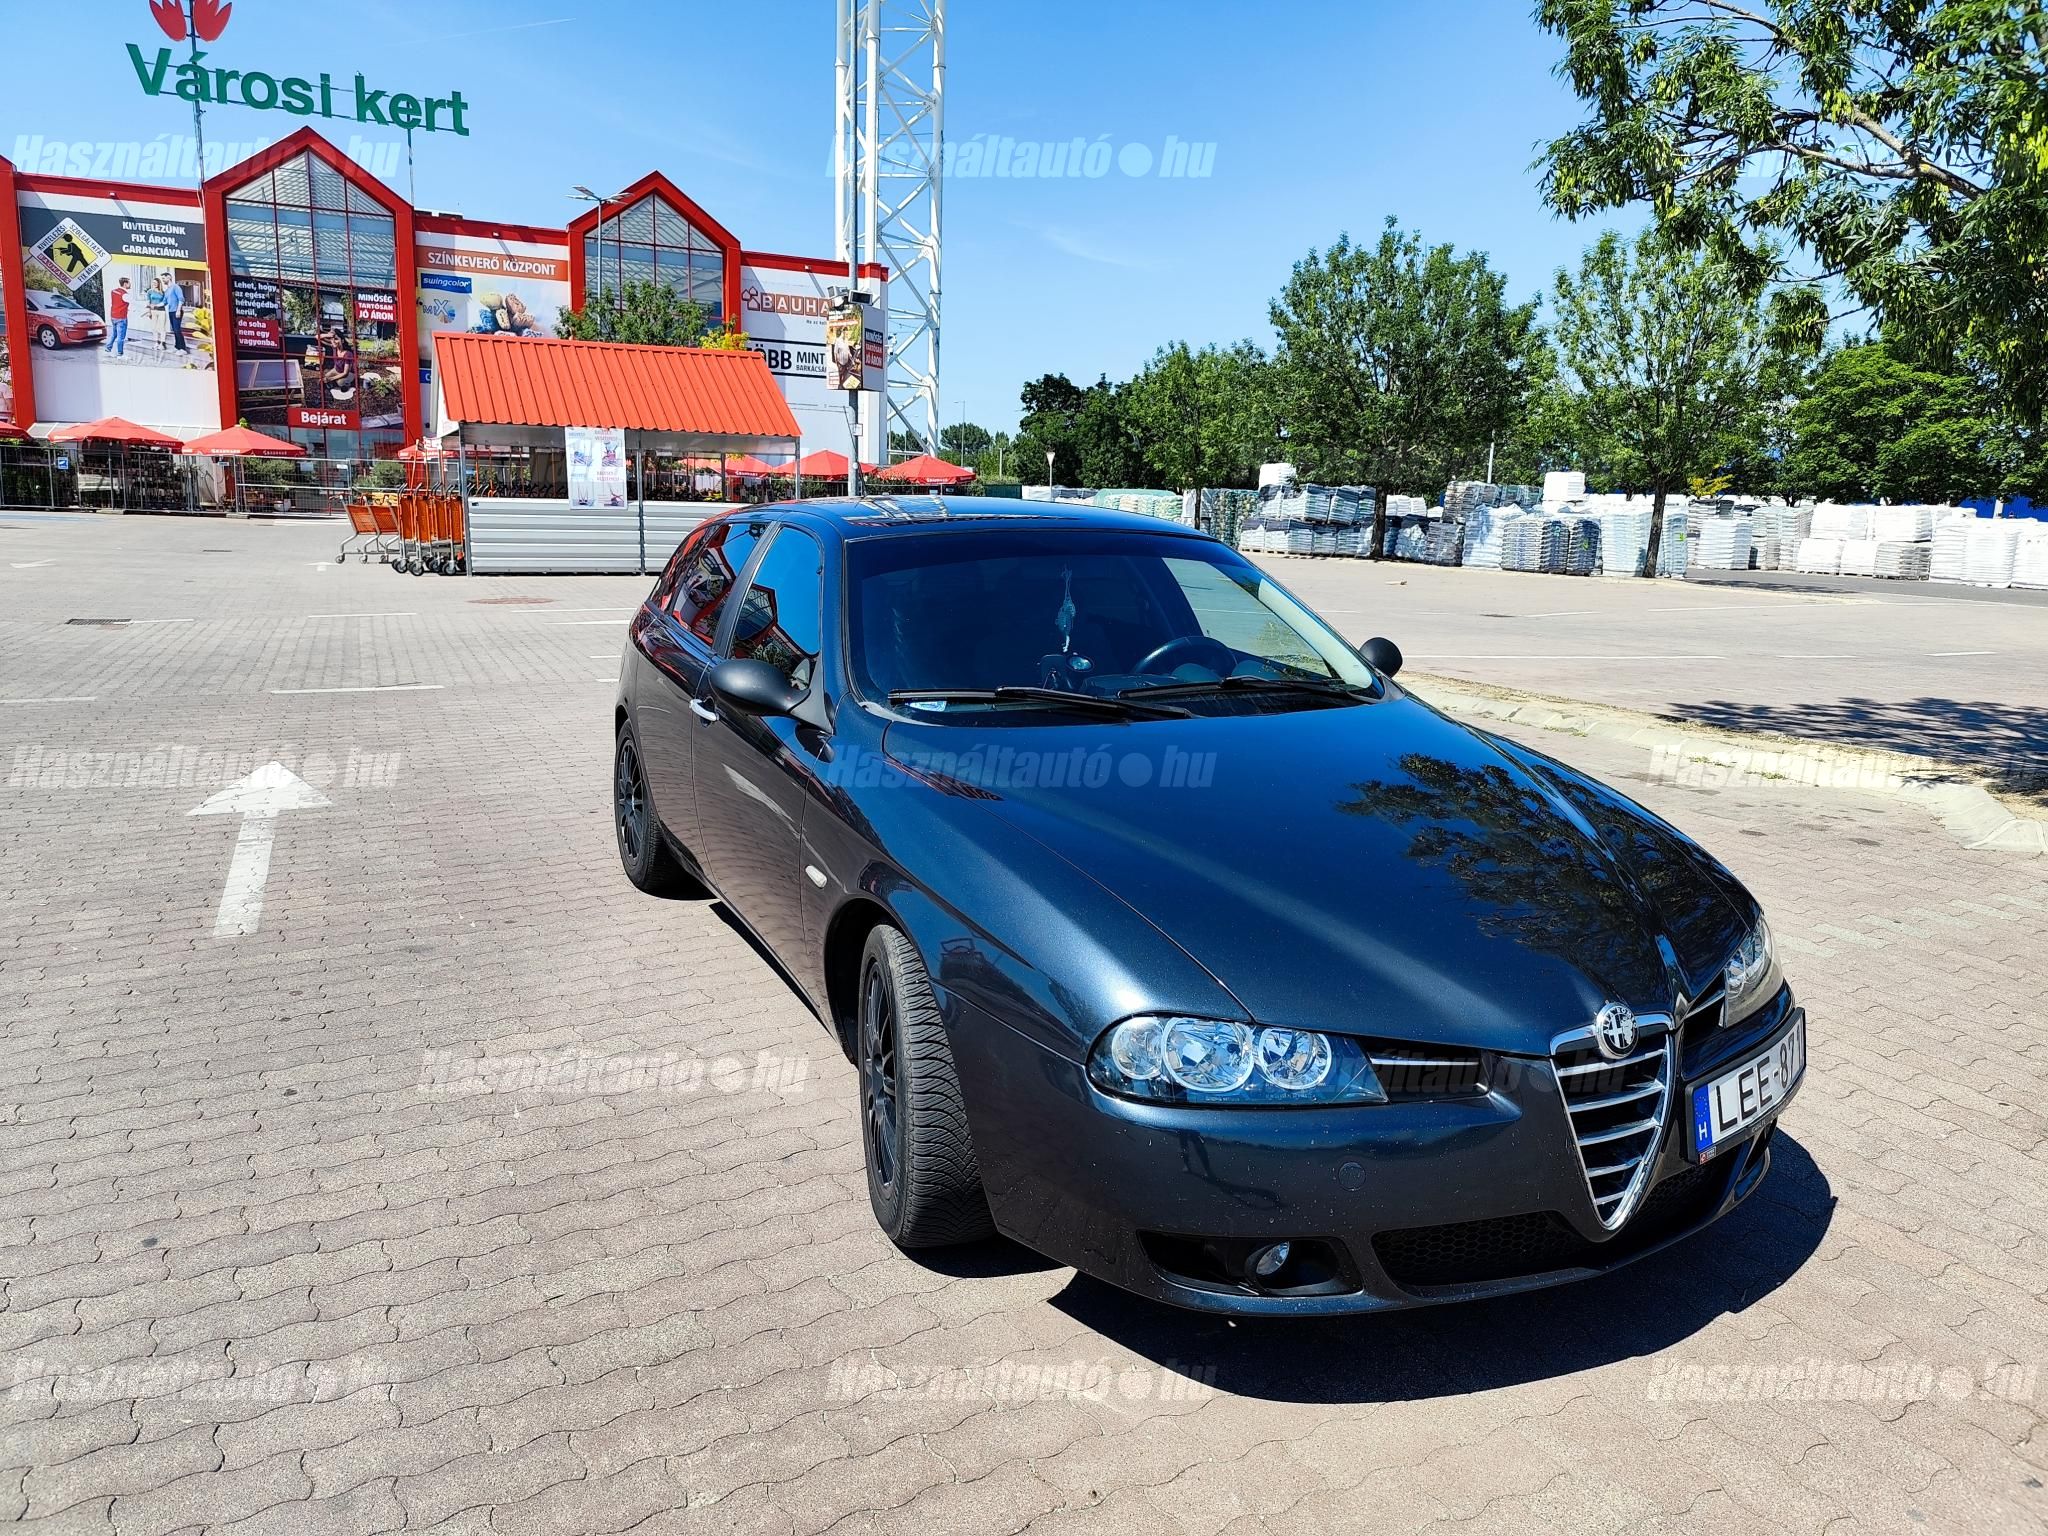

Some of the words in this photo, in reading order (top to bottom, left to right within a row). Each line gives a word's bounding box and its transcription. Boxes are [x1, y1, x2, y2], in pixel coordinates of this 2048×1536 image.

[125, 43, 332, 118] Városi
[354, 74, 469, 136] kert
[122, 221, 186, 235] KIVITELEZÜNK
[132, 235, 146, 244] FIX
[148, 235, 178, 248] ÁRON,
[122, 245, 188, 258] GARANCIÁVAL!
[38, 253, 70, 284] BAUHAUS
[428, 251, 500, 270] SZÍNKEVERŐ
[503, 258, 556, 276] KÖZPONT
[234, 281, 256, 290] Lehet,
[423, 276, 471, 288] swingcolor
[358, 293, 392, 303] MINŐSÉG
[236, 308, 257, 316] kerül,
[358, 302, 393, 310] TARTÓSAN
[359, 309, 369, 318] JÓ
[370, 310, 394, 320] ÁRON
[240, 338, 278, 346] vagyonba.
[796, 351, 825, 364] MINT
[301, 411, 347, 426] Bejárat
[1698, 1121, 1708, 1141] H
